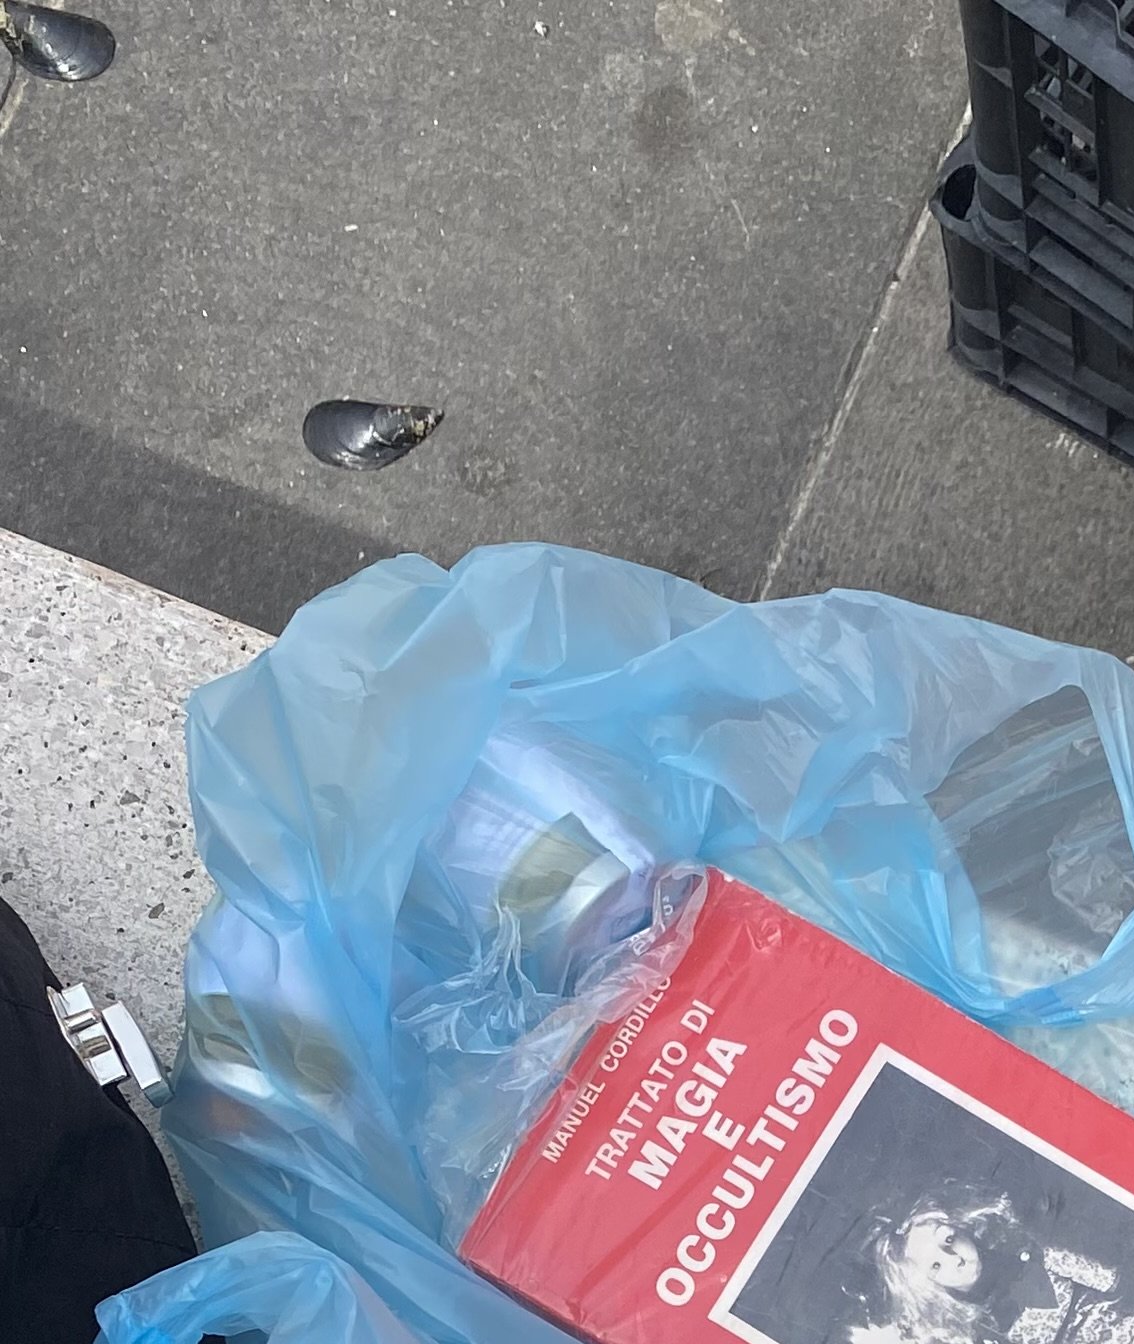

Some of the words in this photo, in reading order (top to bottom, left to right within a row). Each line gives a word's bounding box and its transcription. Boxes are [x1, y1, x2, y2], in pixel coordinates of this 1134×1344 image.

[542, 1081, 606, 1164] MANUEL
[584, 1040, 688, 1181] TRATTATO
[680, 999, 716, 1035] DI
[627, 1036, 748, 1191] MAGIA
[656, 1009, 859, 1307] OCCULTISMO
[702, 1110, 746, 1151] E
